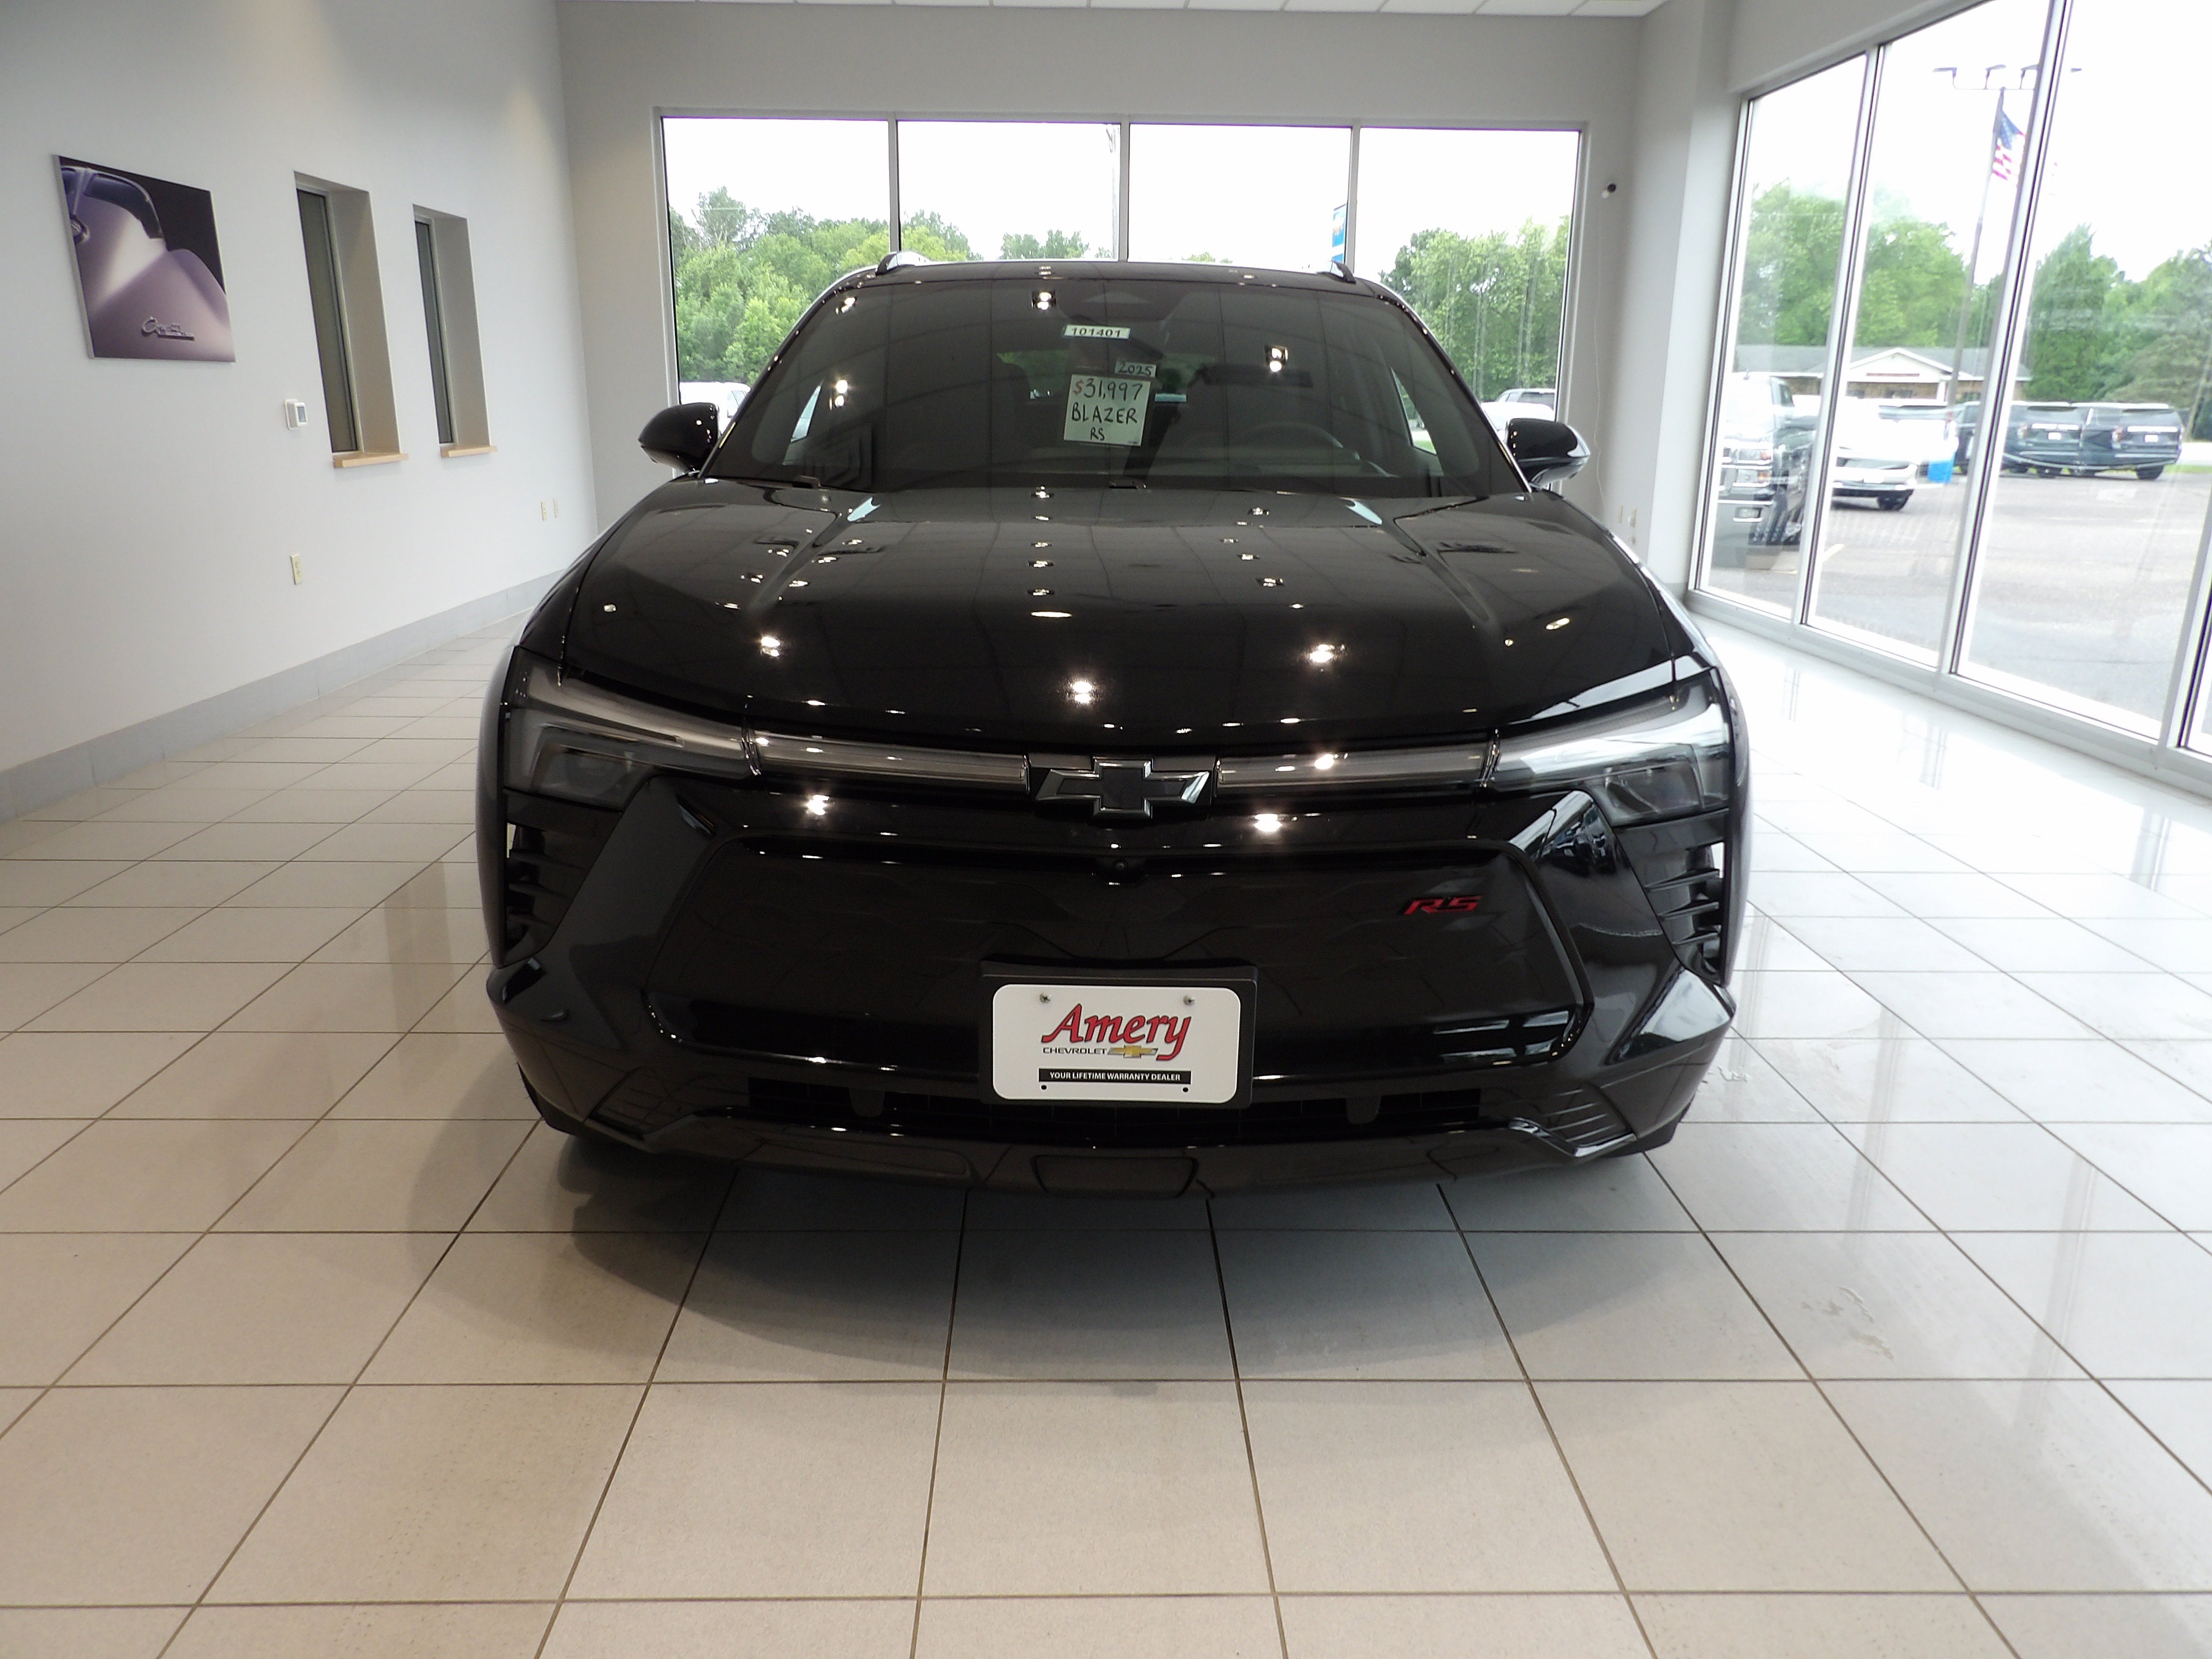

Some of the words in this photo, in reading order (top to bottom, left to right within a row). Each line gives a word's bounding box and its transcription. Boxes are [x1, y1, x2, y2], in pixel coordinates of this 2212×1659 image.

[1071, 327, 1121, 337] 101401
[1118, 362, 1153, 376] 2025
[1073, 378, 1143, 401] $31,997
[1071, 402, 1138, 424] BLAZER
[1090, 427, 1105, 441] RS
[1404, 895, 1482, 915] RS
[1040, 1003, 1192, 1061] Amery
[1049, 1071, 1071, 1079] YOUR
[1072, 1072, 1106, 1080] LIFETIME
